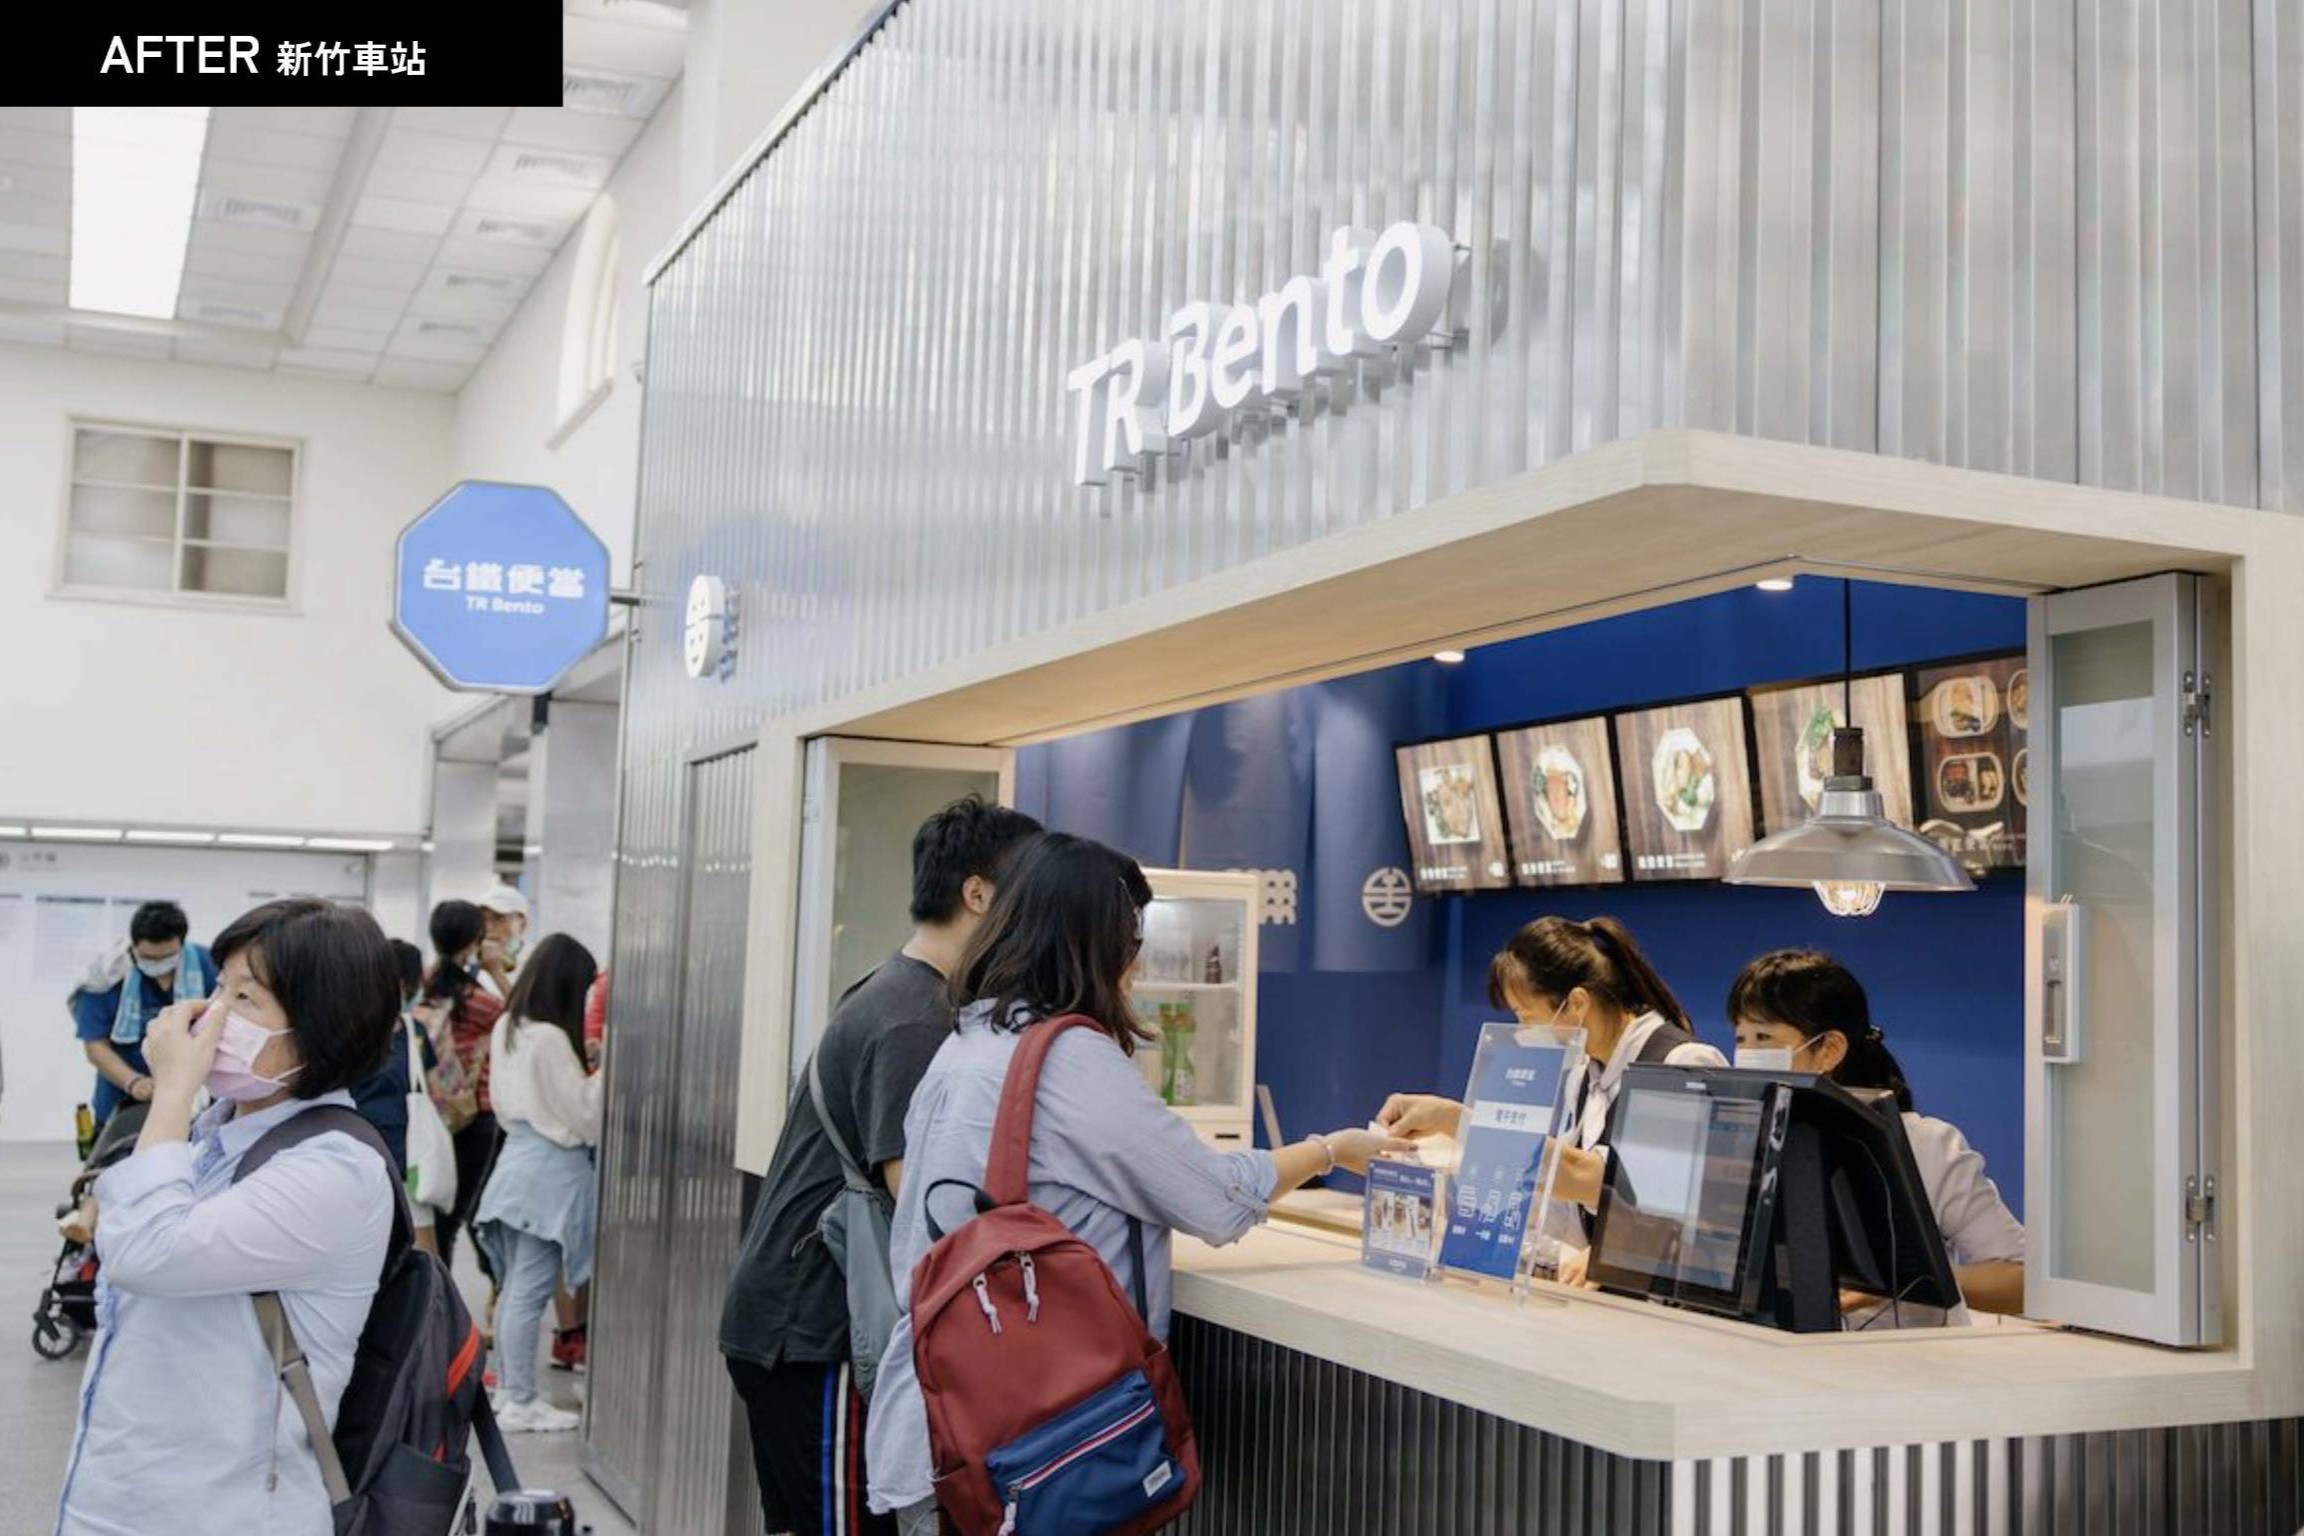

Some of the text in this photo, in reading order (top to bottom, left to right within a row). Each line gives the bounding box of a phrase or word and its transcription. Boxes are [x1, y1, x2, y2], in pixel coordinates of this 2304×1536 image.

[1068, 221, 1450, 486] TR Bento
[423, 558, 585, 599] 台鐵便當
[465, 595, 545, 615] TR Bento
